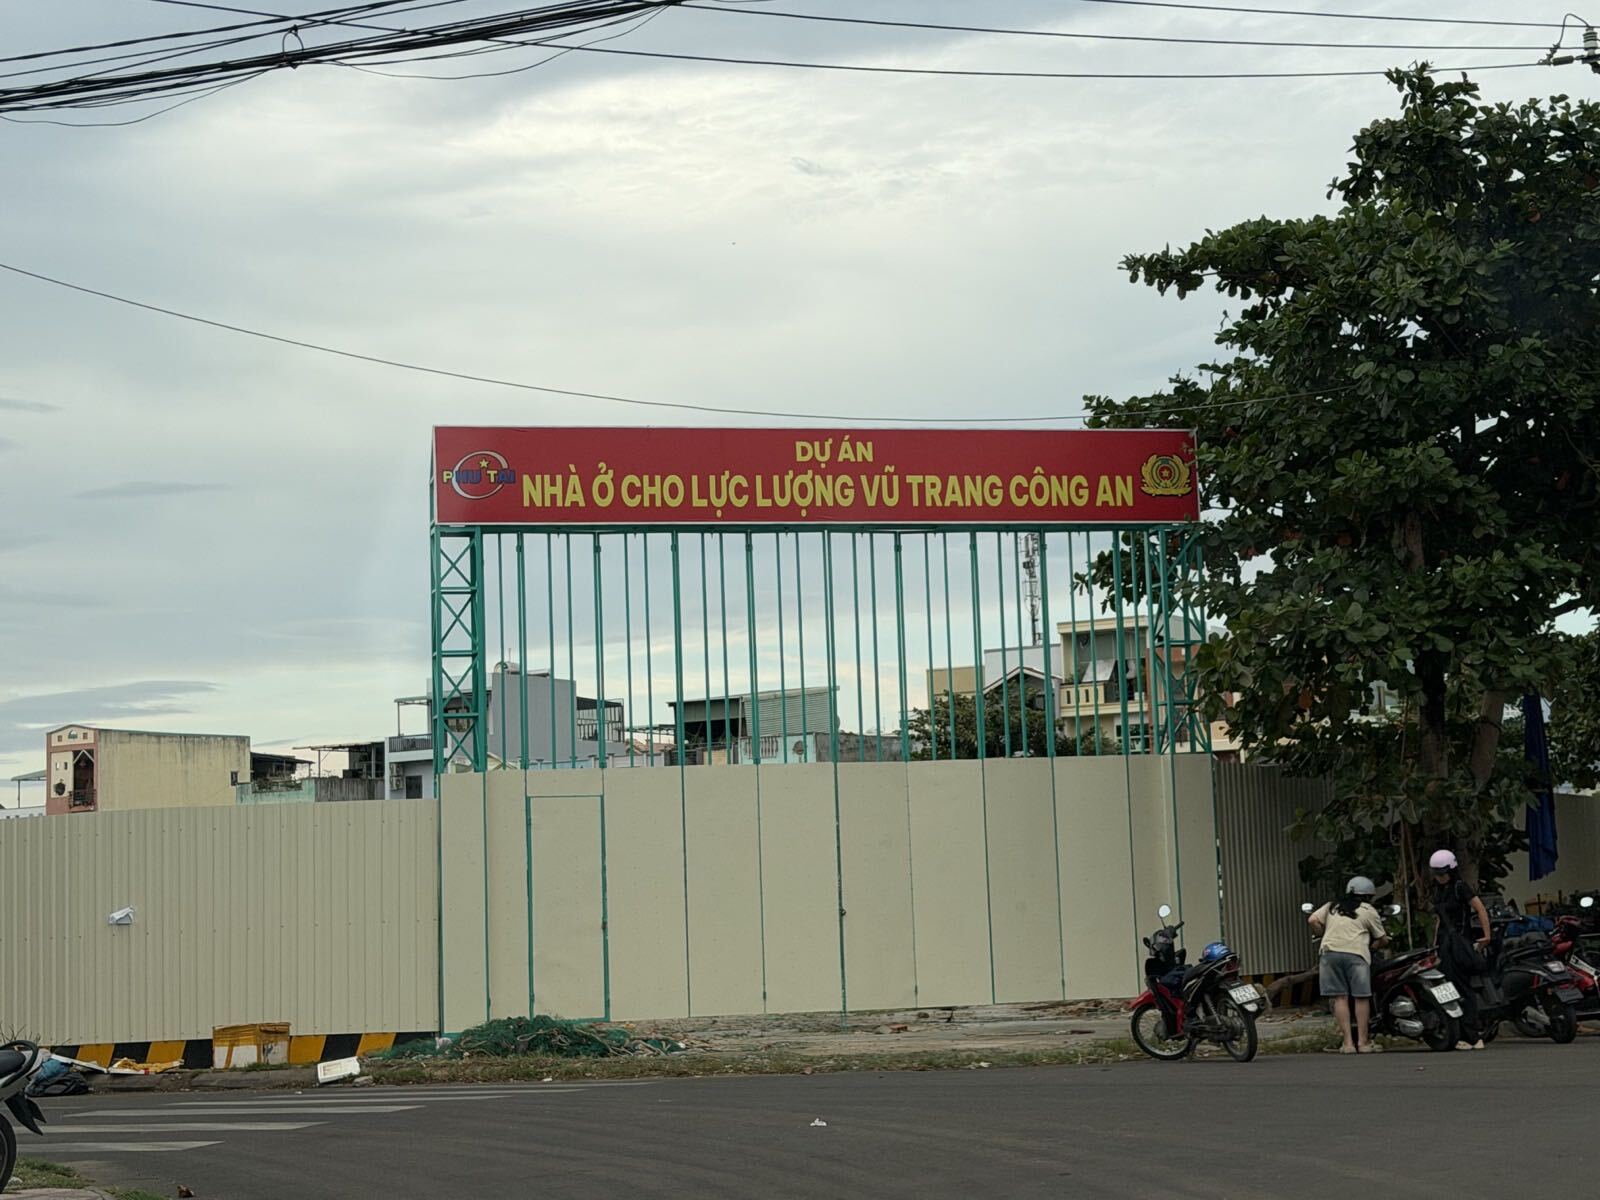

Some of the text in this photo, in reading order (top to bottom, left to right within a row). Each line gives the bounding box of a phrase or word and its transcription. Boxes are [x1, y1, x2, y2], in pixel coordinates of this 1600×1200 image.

[795, 434, 874, 469] DỰ ÁN
[522, 462, 1134, 518] NHÀ Ở CHO LỰC LƯỢNG VŨ TRANG CÔNG AN
